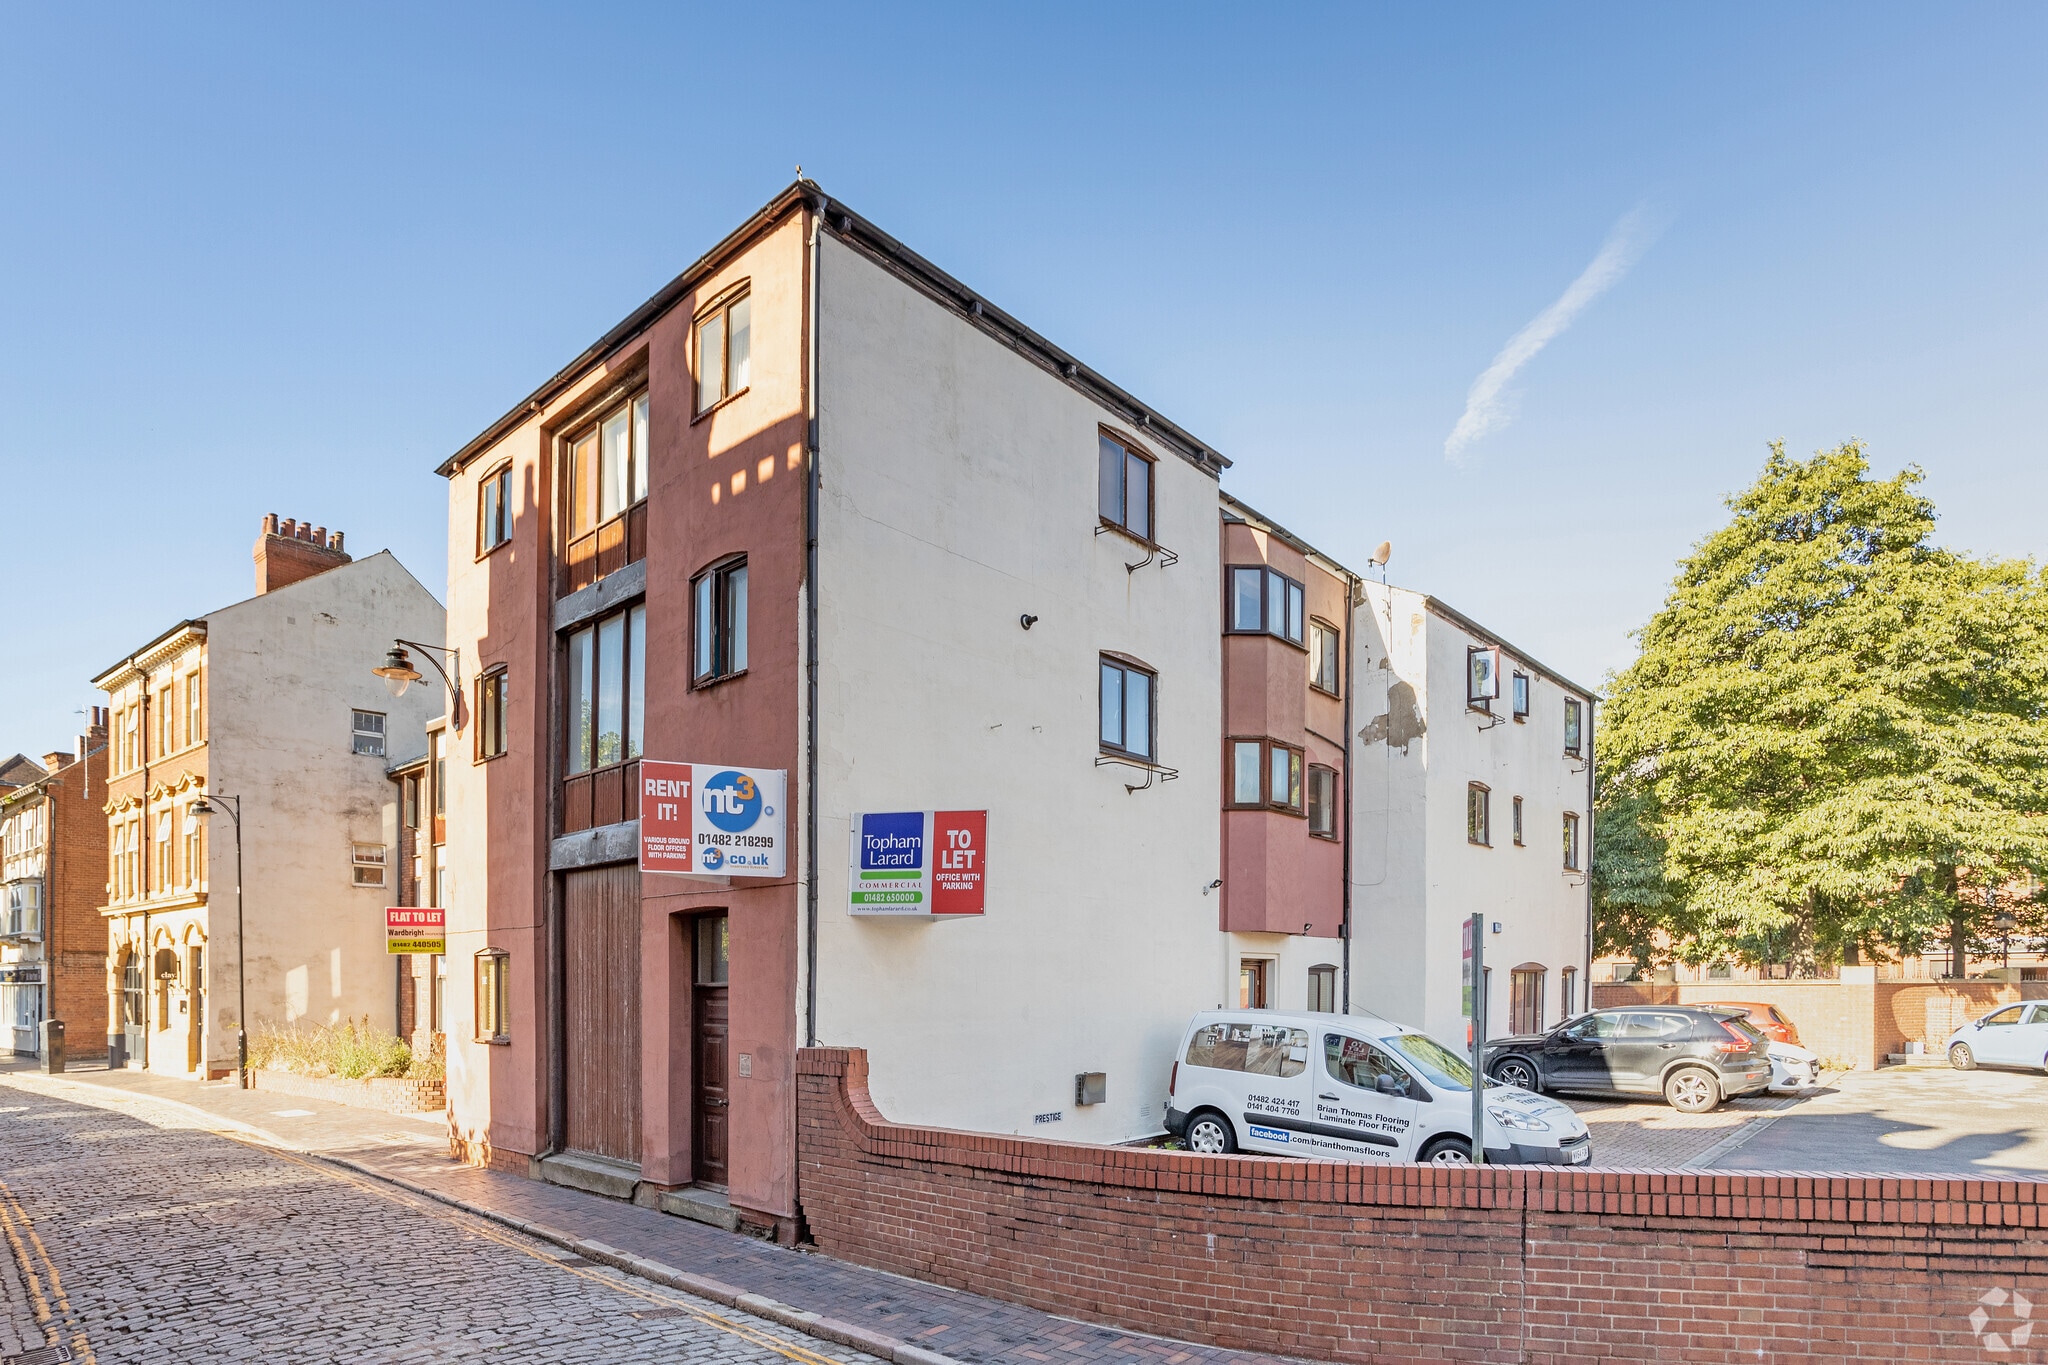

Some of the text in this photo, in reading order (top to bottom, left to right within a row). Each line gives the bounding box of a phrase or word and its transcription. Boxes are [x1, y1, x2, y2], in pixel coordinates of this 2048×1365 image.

[645, 778, 690, 798] RENT
[658, 803, 677, 821] IT!
[644, 836, 690, 845] VARIOUS GROUND
[698, 833, 774, 848] 01482 218299
[864, 833, 921, 853] Topham
[946, 829, 972, 849] TO
[663, 852, 686, 860] PARKING
[870, 849, 914, 866] Larard
[941, 850, 976, 869] LET
[936, 873, 980, 881] OFFICE WITH
[942, 882, 973, 890] PARKING
[864, 893, 915, 902] 01482 650000
[857, 905, 918, 913] www.tophamlarard.co.uk
[390, 911, 442, 923] FLAT TO LET
[388, 929, 425, 938] Wardbright
[1248, 1094, 1300, 1108] 01482 424 417
[1247, 1102, 1300, 1116] 0141 404 7760
[1317, 1104, 1410, 1127] Brian Thomas Flooring
[1034, 1112, 1062, 1124] PRESTIGE
[1319, 1113, 1406, 1134] Laminate Floor Fitter
